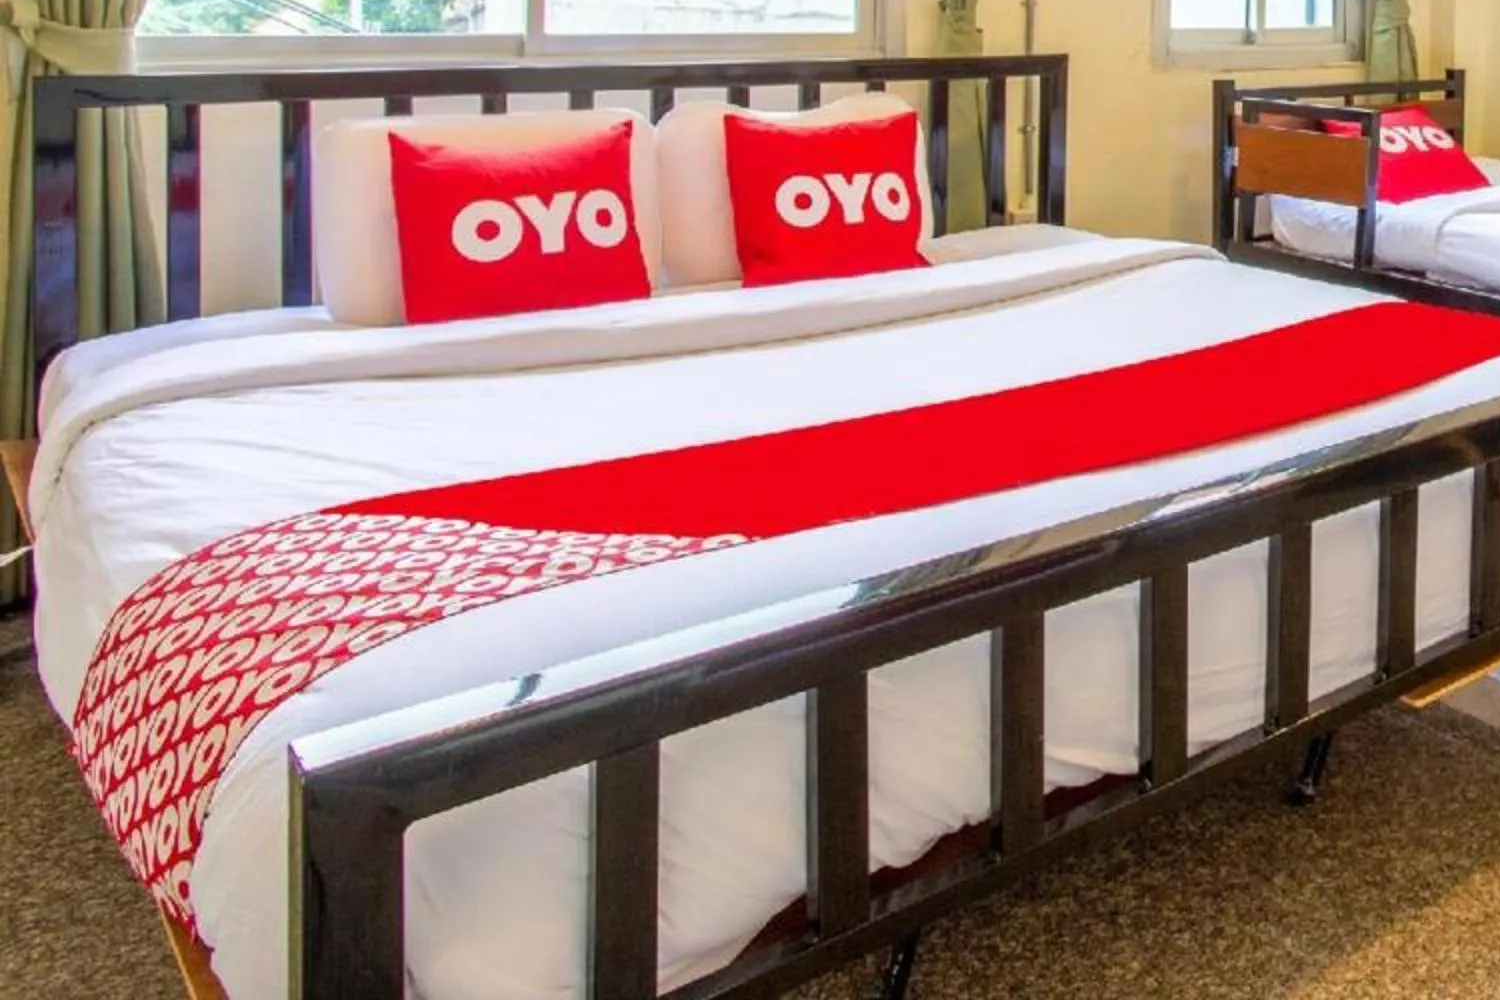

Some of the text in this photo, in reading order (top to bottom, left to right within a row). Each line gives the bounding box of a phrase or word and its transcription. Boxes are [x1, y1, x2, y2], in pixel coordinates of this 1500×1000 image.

[1380, 126, 1456, 153] OYO
[451, 190, 628, 263] OYO
[775, 172, 911, 228] OYO
